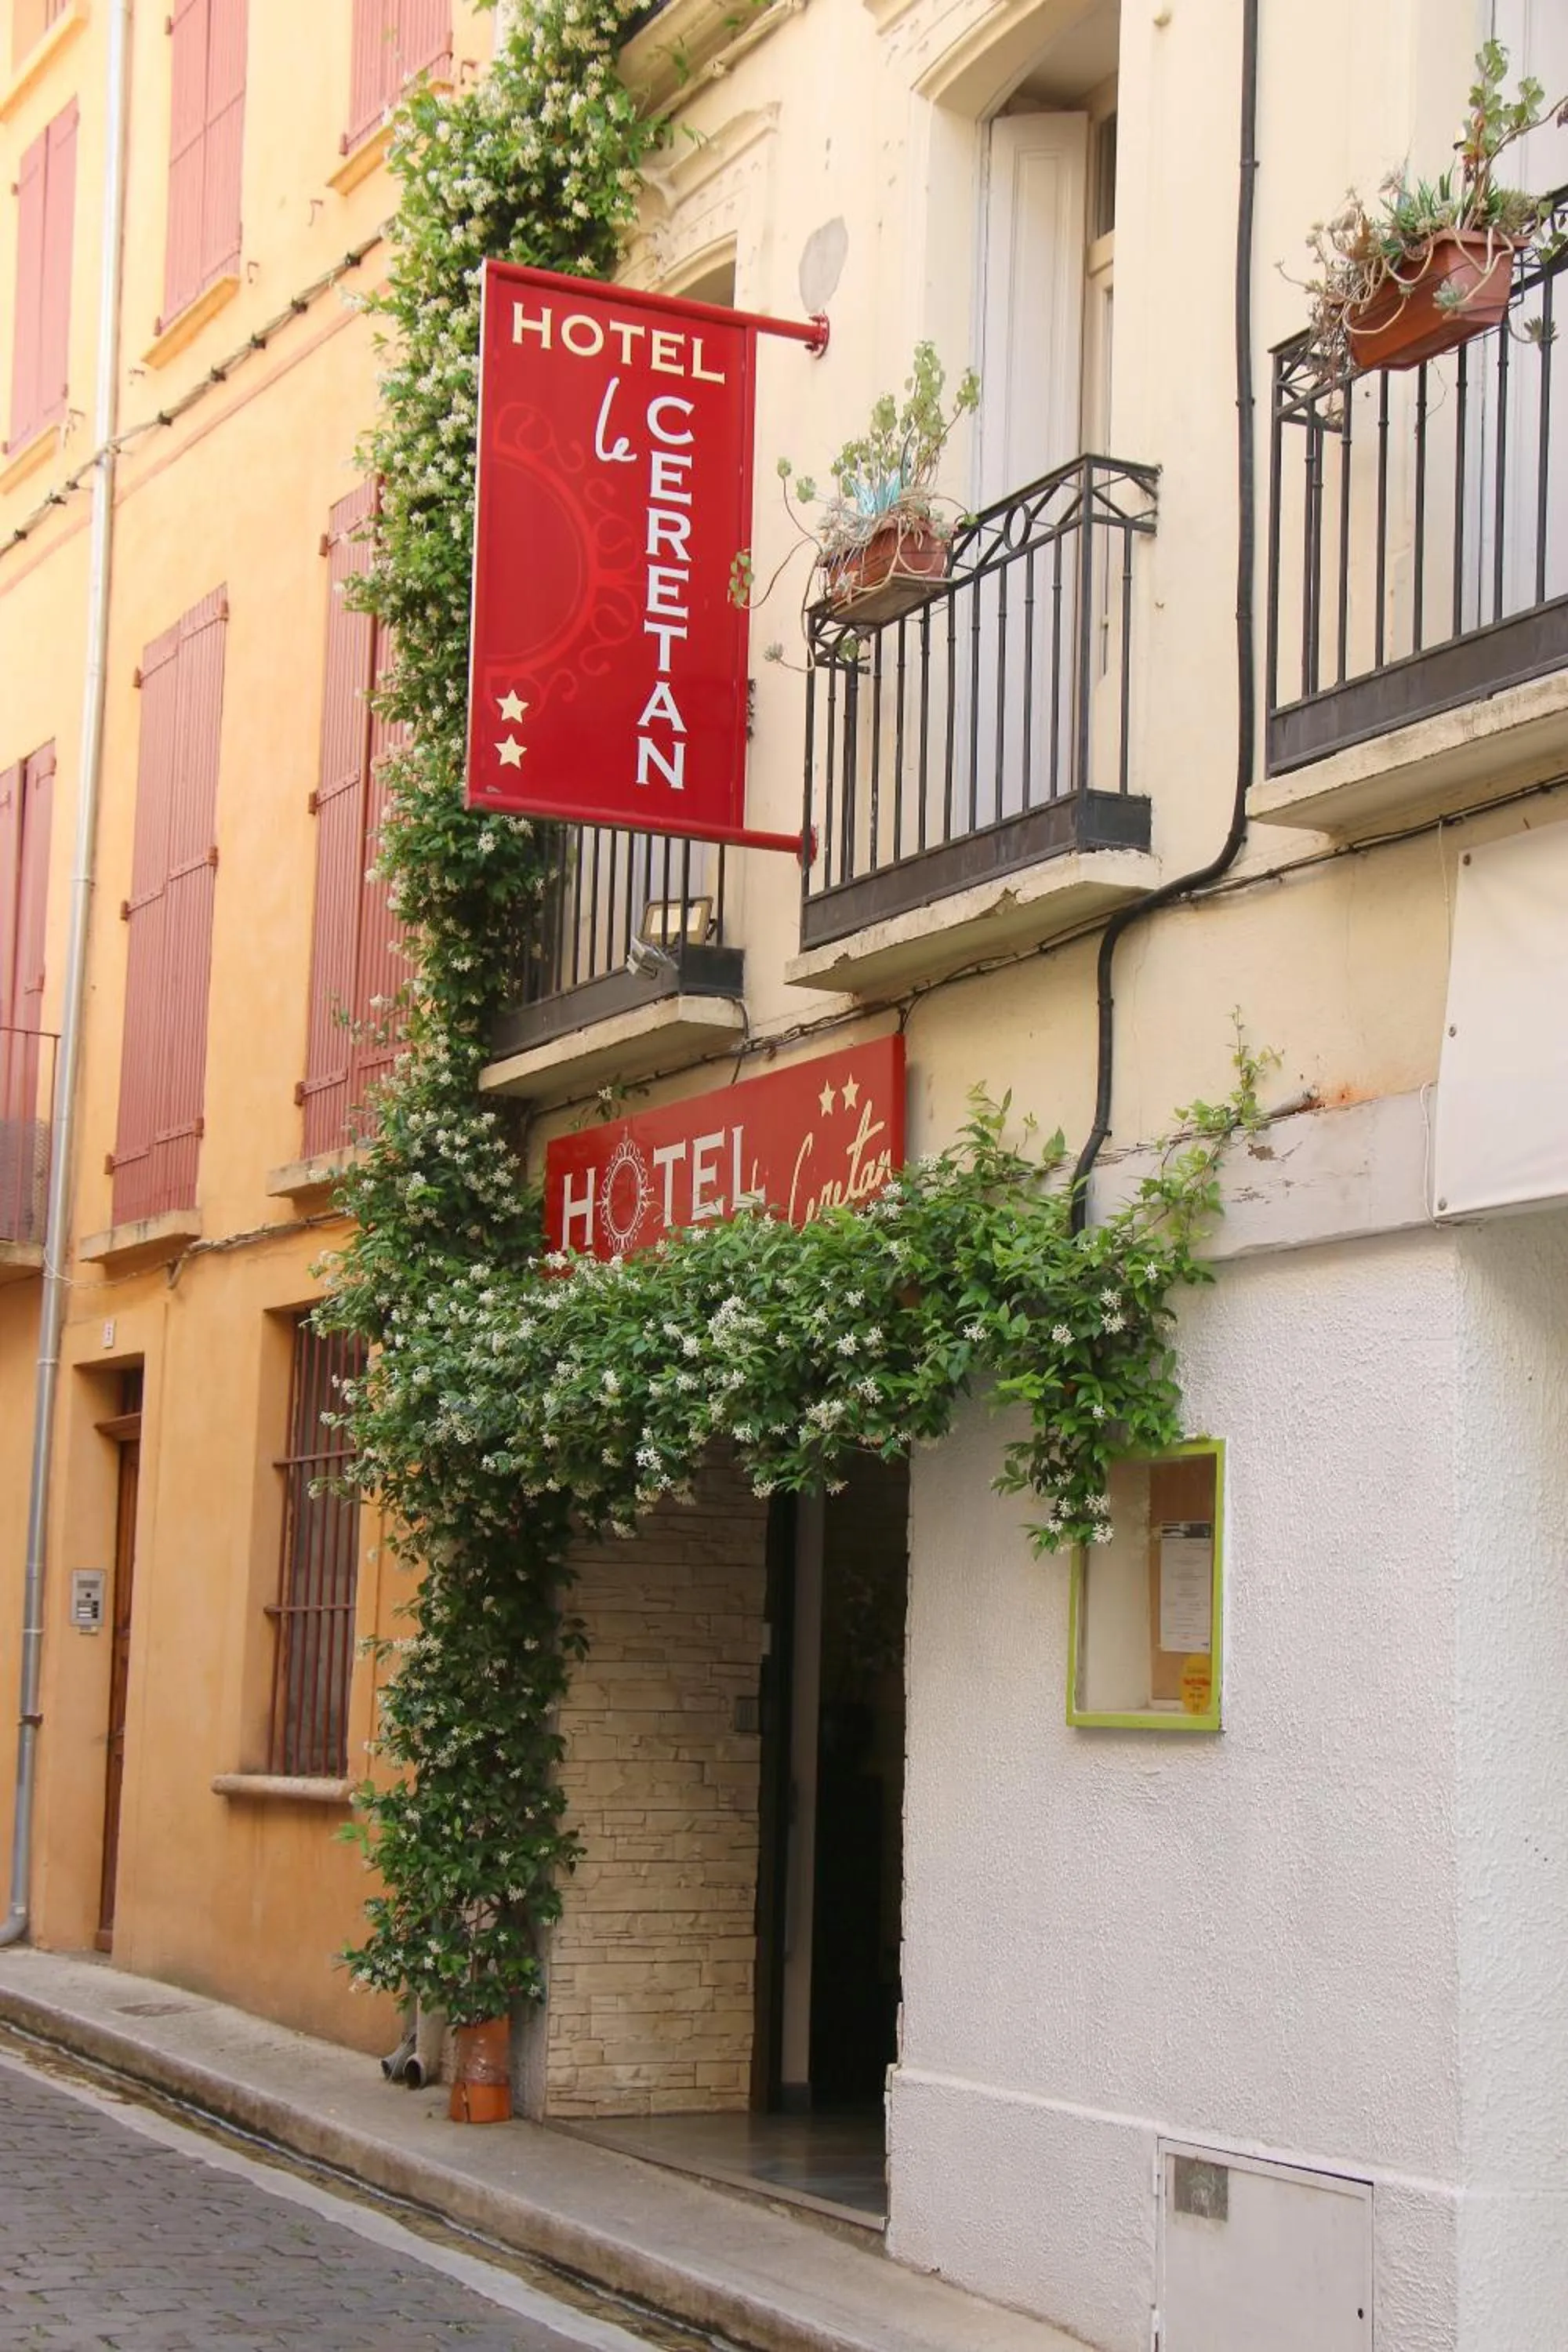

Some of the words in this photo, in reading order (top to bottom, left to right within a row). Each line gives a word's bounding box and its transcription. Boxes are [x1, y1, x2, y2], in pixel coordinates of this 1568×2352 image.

[511, 302, 725, 384] HOTEL
[635, 394, 695, 790] CERETAN
[561, 1124, 767, 1254] HOTEL
